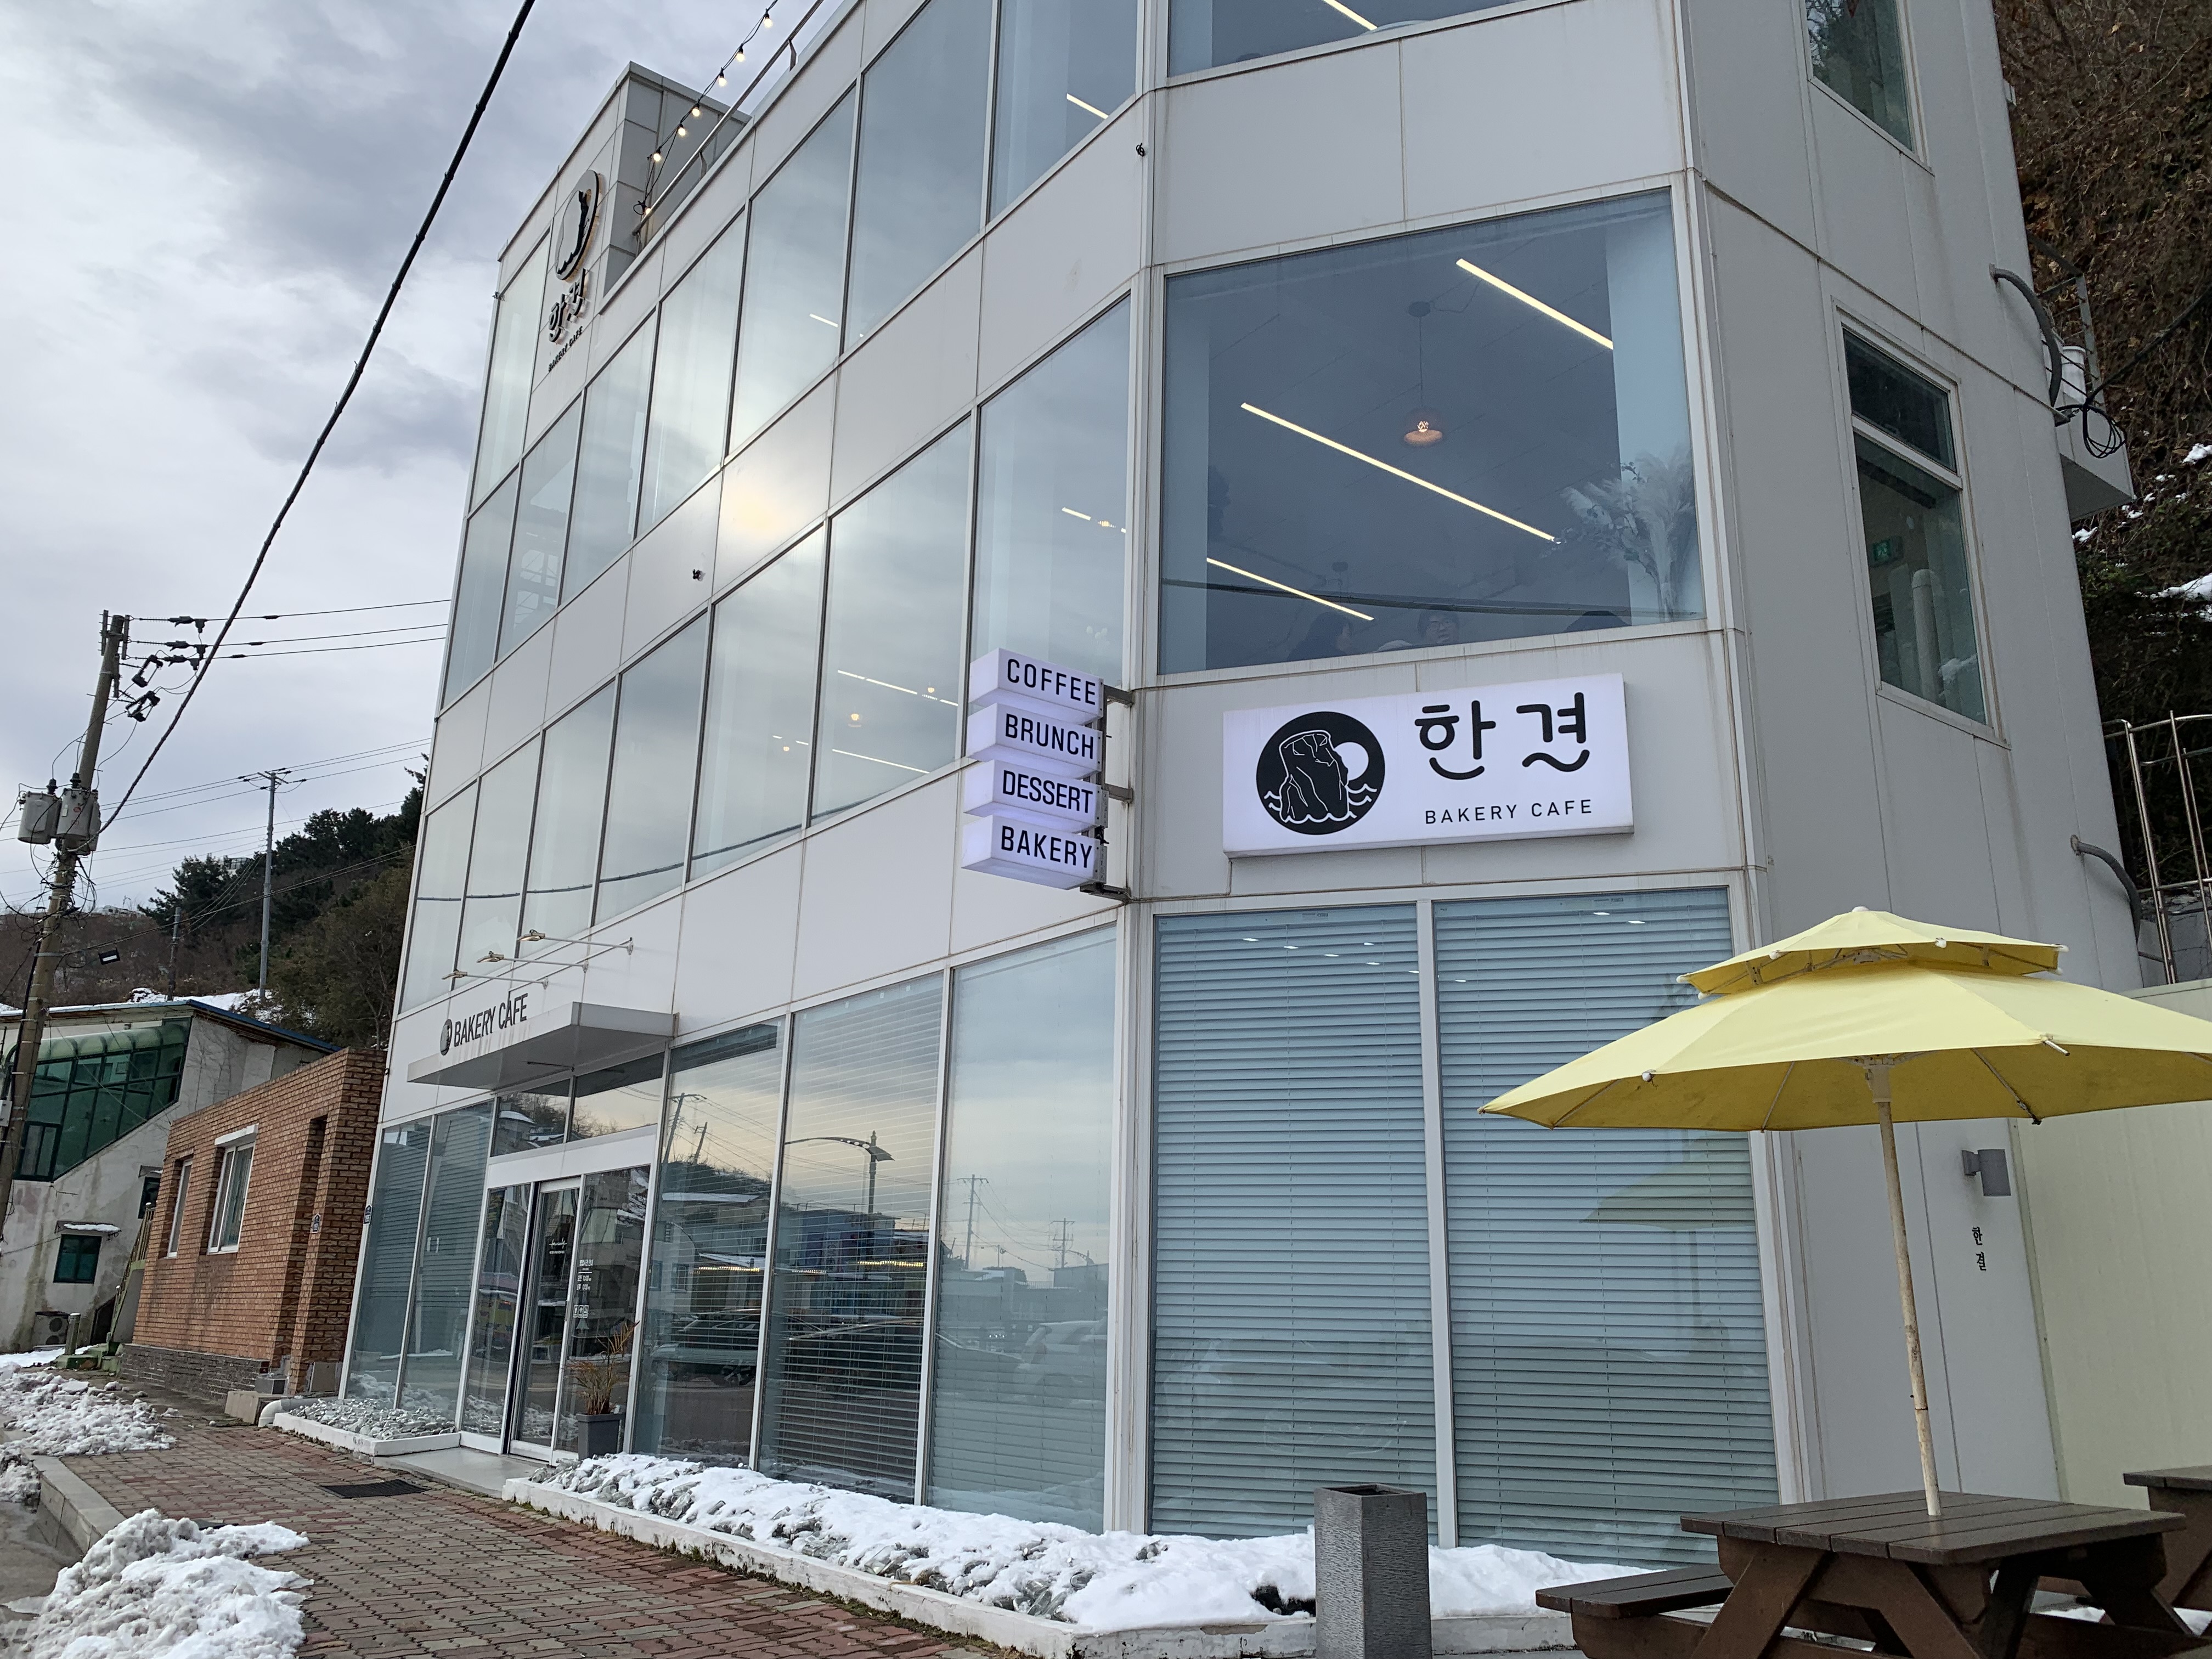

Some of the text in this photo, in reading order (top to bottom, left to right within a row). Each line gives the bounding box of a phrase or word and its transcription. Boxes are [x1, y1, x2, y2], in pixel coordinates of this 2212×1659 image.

[1007, 658, 1096, 706] COFFEE
[1005, 713, 1094, 760] BRUNCH
[1003, 770, 1093, 814] DESSERT
[1425, 799, 1593, 825] BAKERY CAFE
[1001, 825, 1092, 868] BAKERY
[454, 992, 528, 1047] BAKERY CAFE
